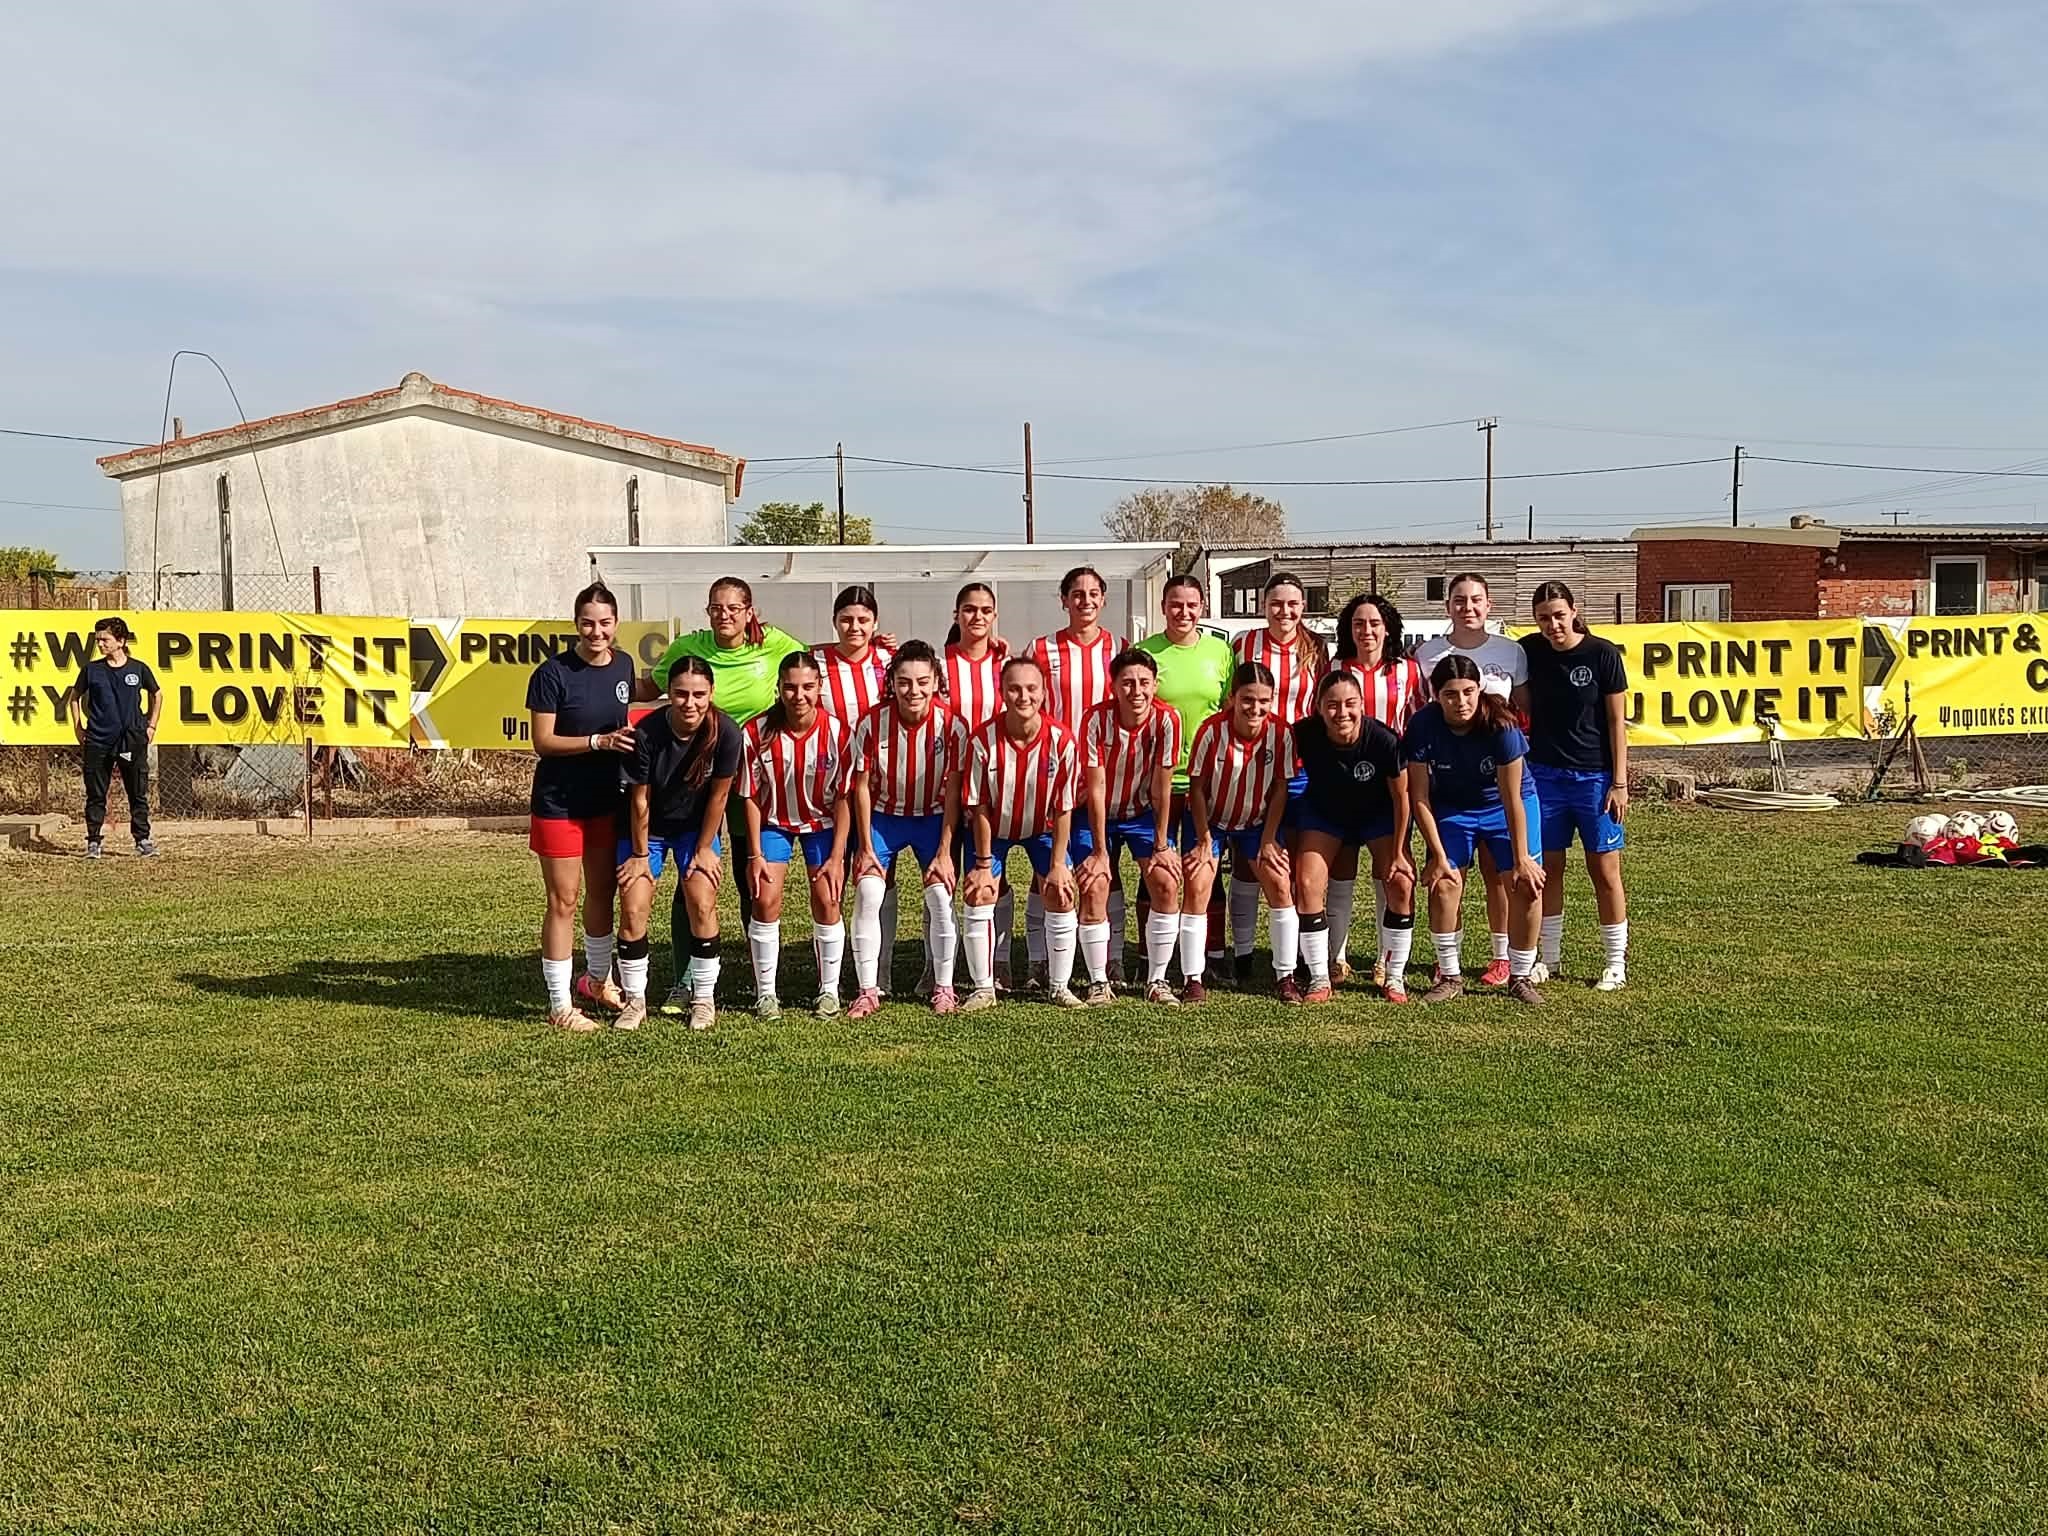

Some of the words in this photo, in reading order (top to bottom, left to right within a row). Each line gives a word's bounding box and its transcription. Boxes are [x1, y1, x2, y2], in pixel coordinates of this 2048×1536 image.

[9, 631, 137, 671] #W
[157, 632, 334, 674] PRINT
[353, 637, 407, 676] IT
[1643, 640, 1793, 680] PRINT
[1808, 637, 1857, 676] IT
[179, 686, 325, 727] LOVE
[344, 687, 398, 728] IT
[1661, 689, 1784, 727] LOVE
[1798, 686, 1848, 723] IT
